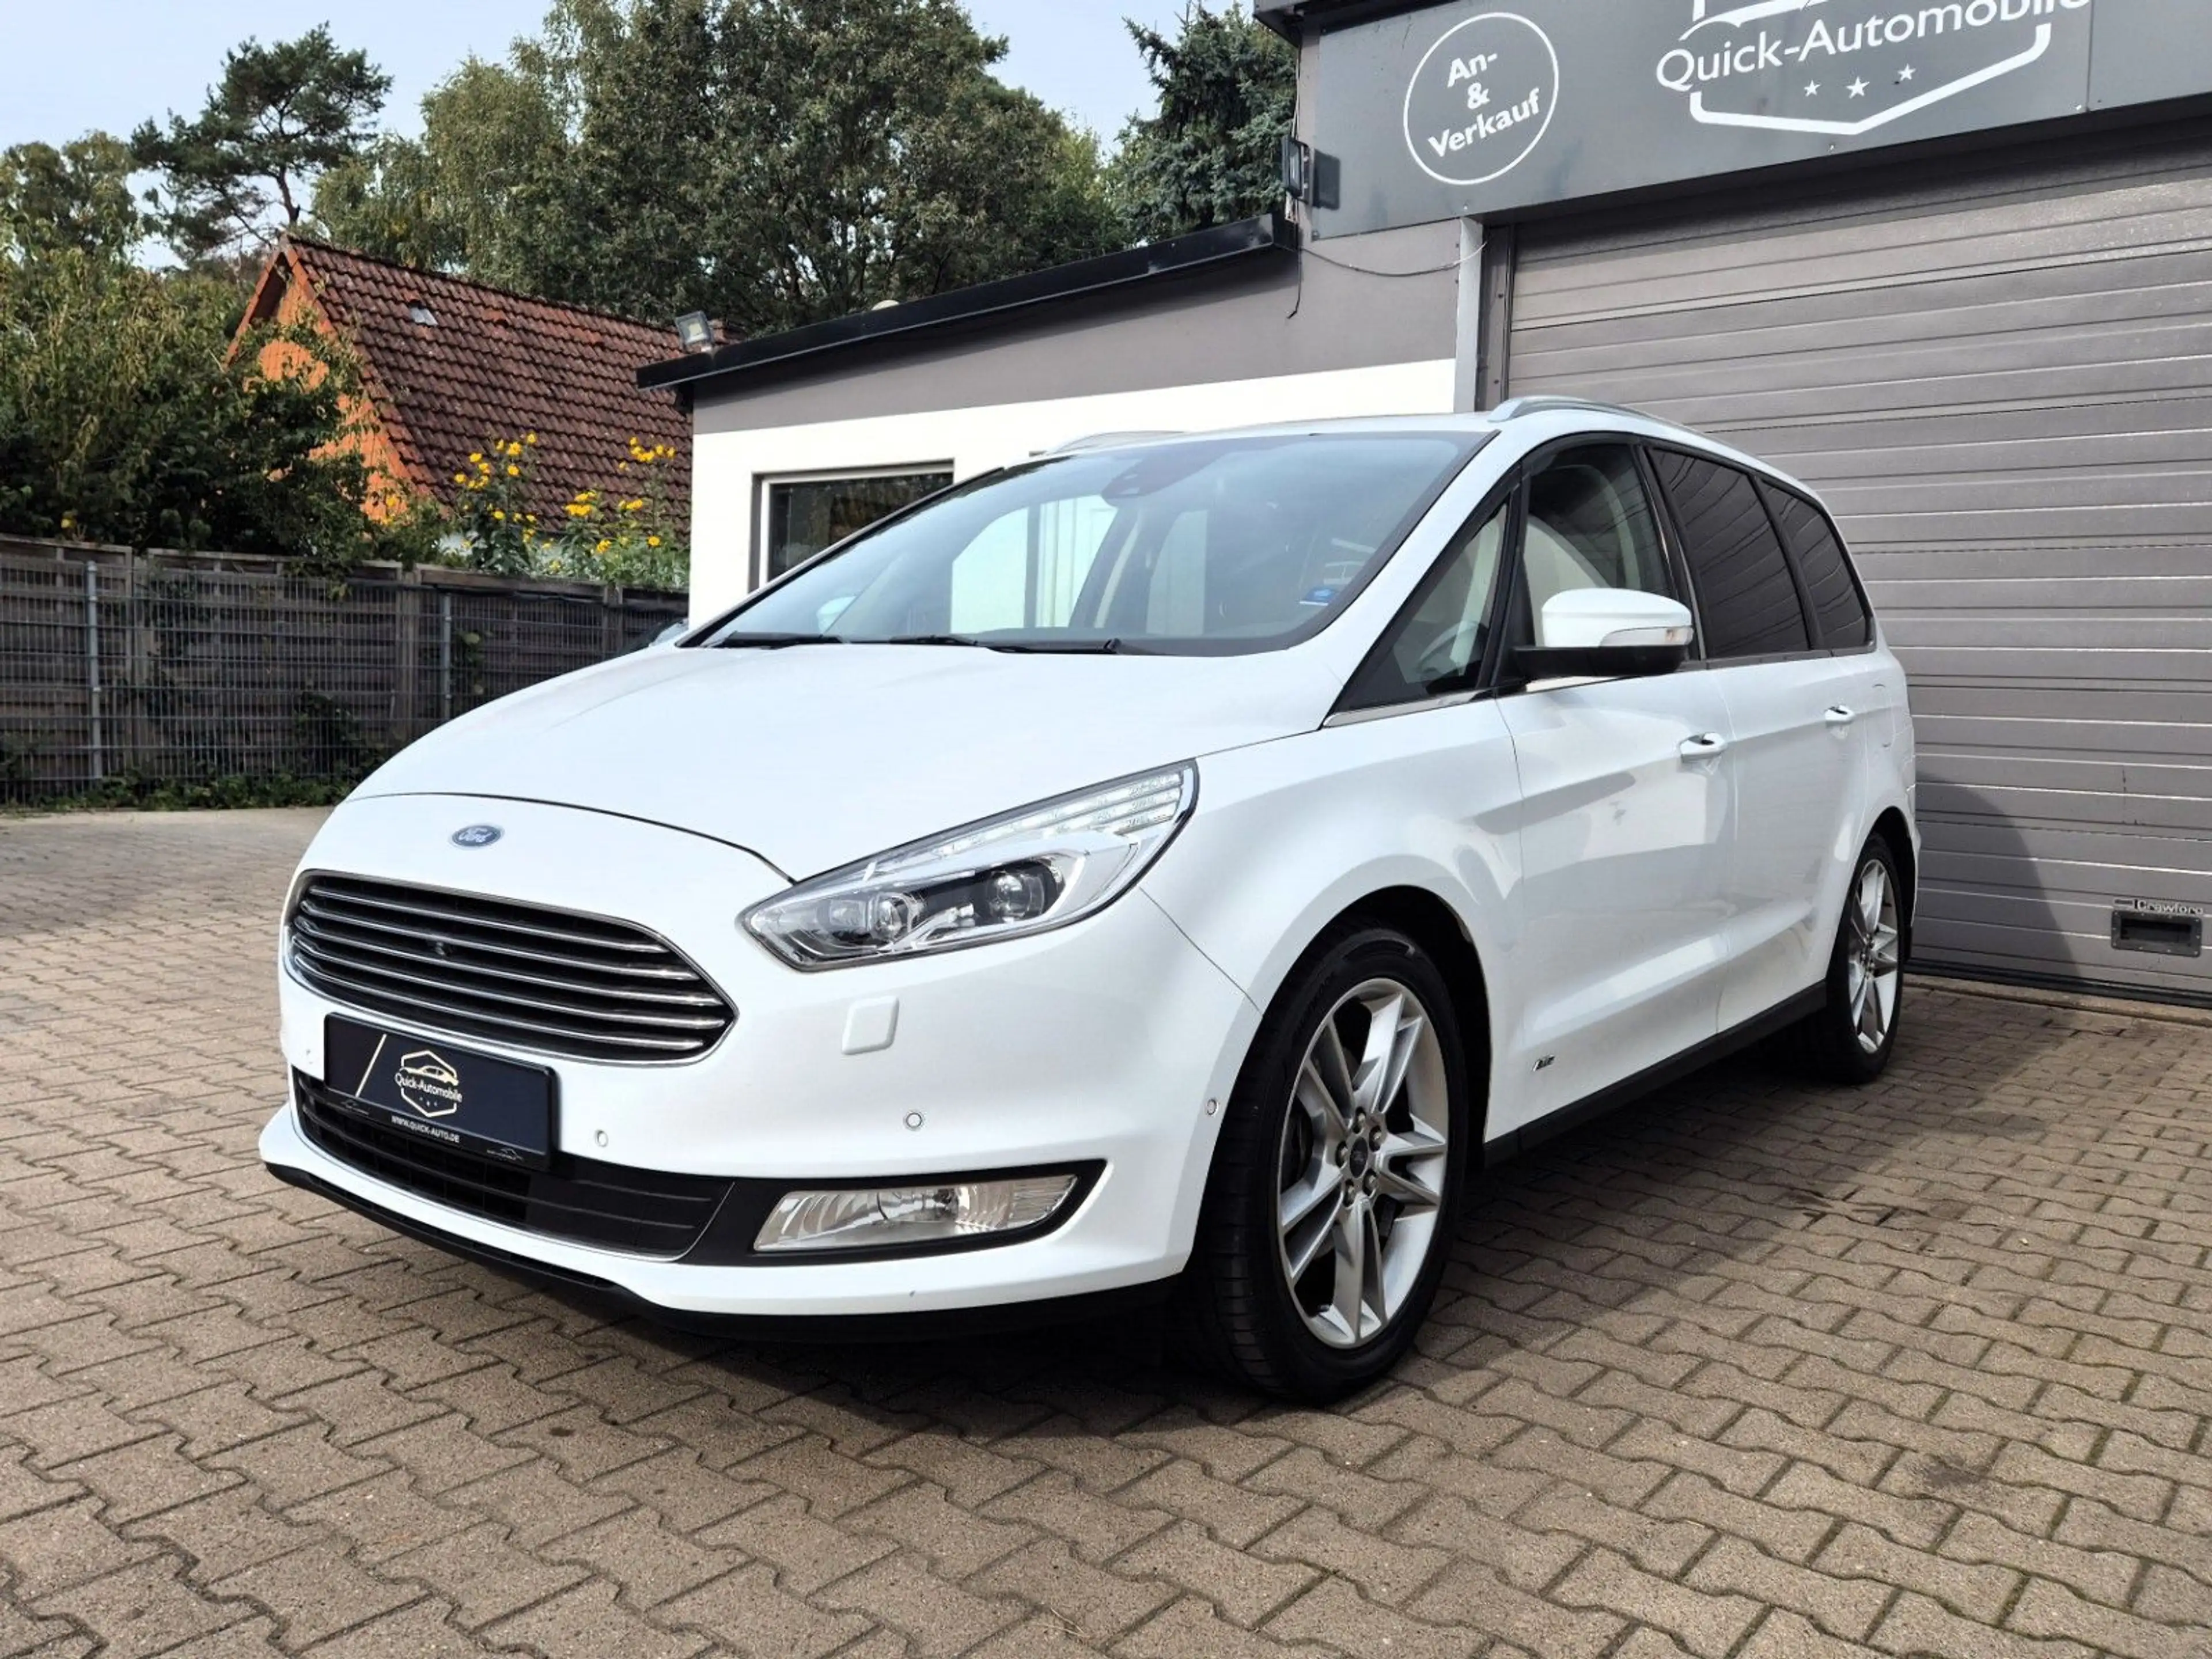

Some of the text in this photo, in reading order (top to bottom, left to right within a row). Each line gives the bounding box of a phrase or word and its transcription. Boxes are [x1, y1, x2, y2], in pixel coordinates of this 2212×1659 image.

[1446, 52, 1498, 88] An-
[1467, 82, 1490, 109] &
[1427, 87, 1540, 157] Verkauf
[395, 1072, 463, 1103] Quick-Automobile
[391, 1115, 460, 1143] WWW.QUICK-AUTO.DE
